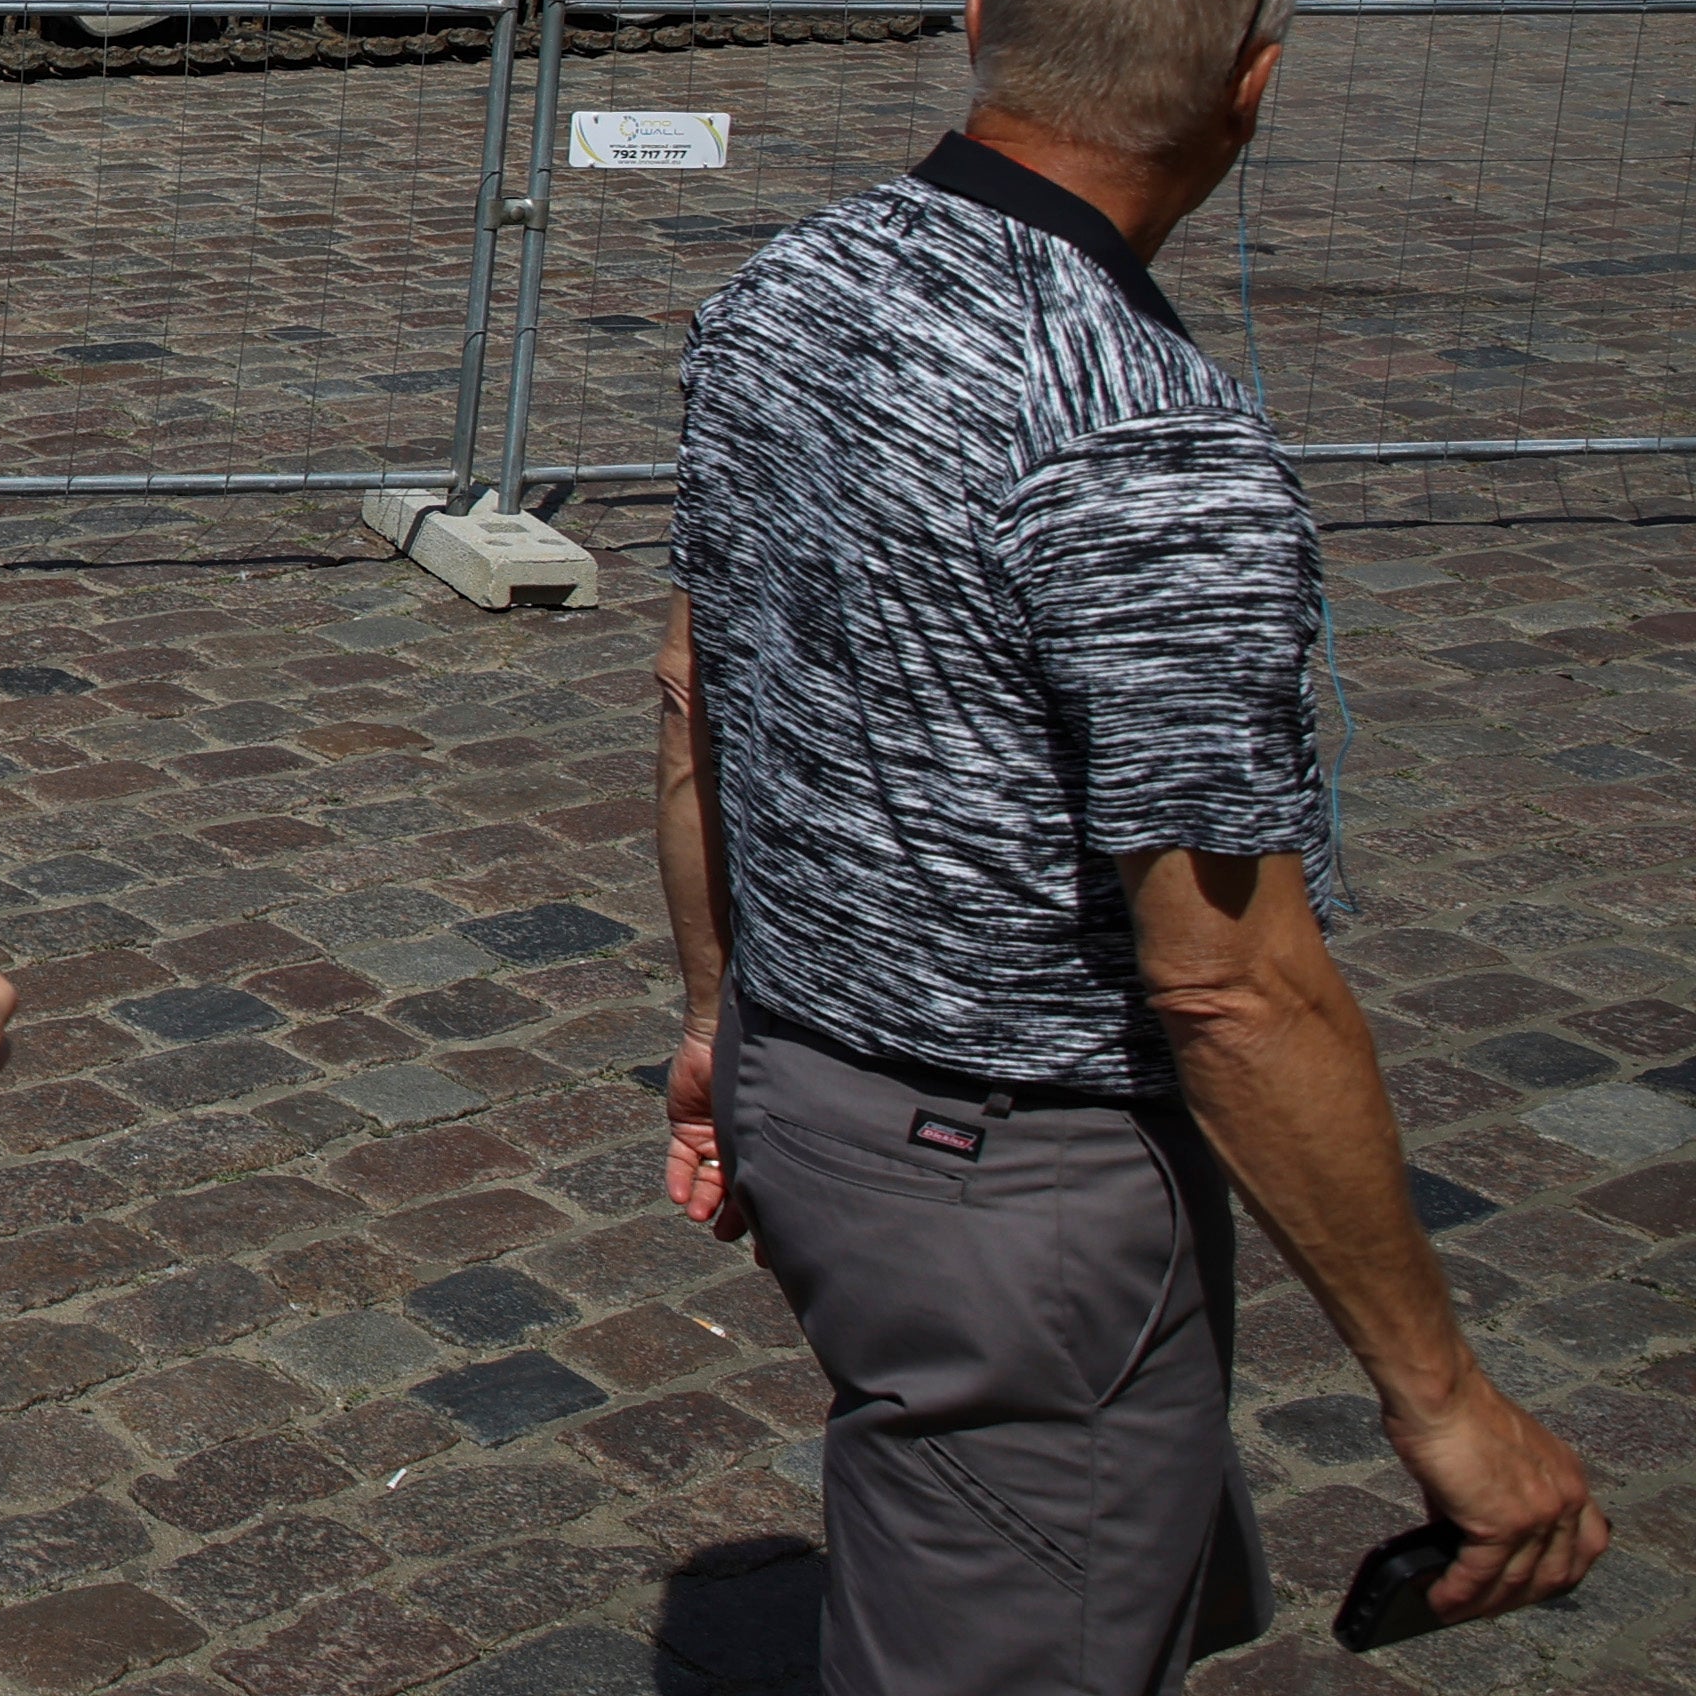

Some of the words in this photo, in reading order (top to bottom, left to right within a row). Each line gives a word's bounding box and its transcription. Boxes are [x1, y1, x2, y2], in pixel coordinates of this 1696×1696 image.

[612, 150, 637, 159] 792
[640, 150, 661, 159] 717
[663, 150, 688, 159] 777
